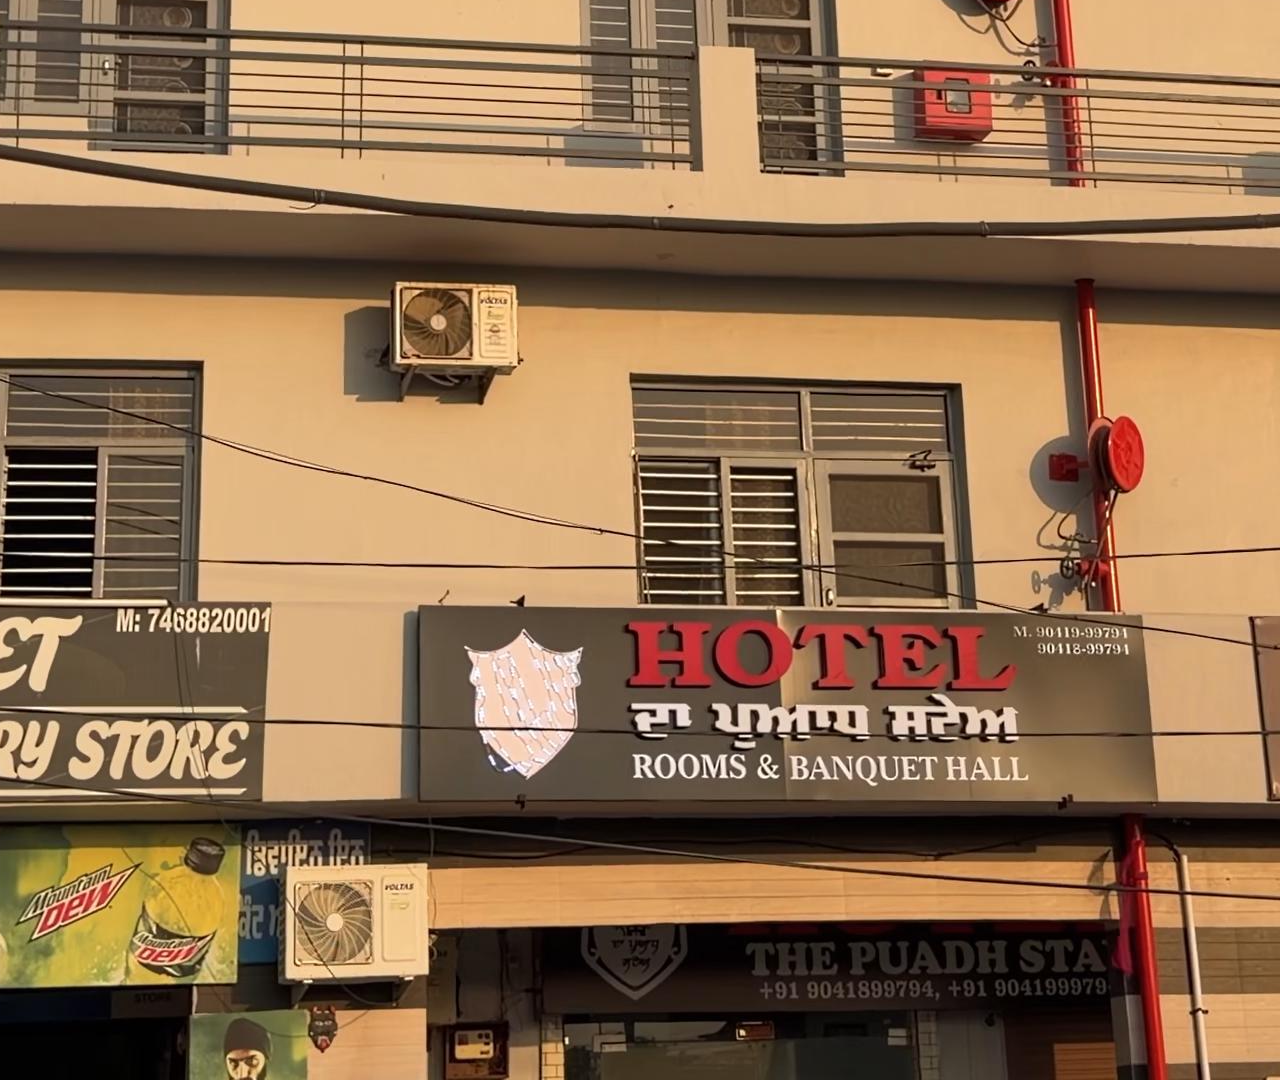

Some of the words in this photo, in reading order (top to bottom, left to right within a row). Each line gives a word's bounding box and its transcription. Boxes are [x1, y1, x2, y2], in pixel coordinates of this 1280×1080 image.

[116, 608, 141, 633] M:
[147, 607, 271, 633] 7468820001
[625, 620, 1017, 689] HOTEL
[629, 703, 691, 738] ਦਾ
[68, 719, 249, 781] STORE
[632, 754, 746, 780] ROOMS
[756, 754, 780, 780] &
[789, 755, 938, 787] BANQUET
[944, 756, 1029, 781] HALL
[21, 866, 112, 921] Mountain
[385, 883, 414, 891] VOLTAS
[746, 941, 838, 976] THE
[848, 940, 1009, 976] PUADH
[1019, 939, 1111, 974] STA
[760, 982, 800, 999] +91
[807, 980, 940, 1001] 9041899794,
[948, 979, 986, 997] +91
[995, 977, 1112, 997] 904199979
